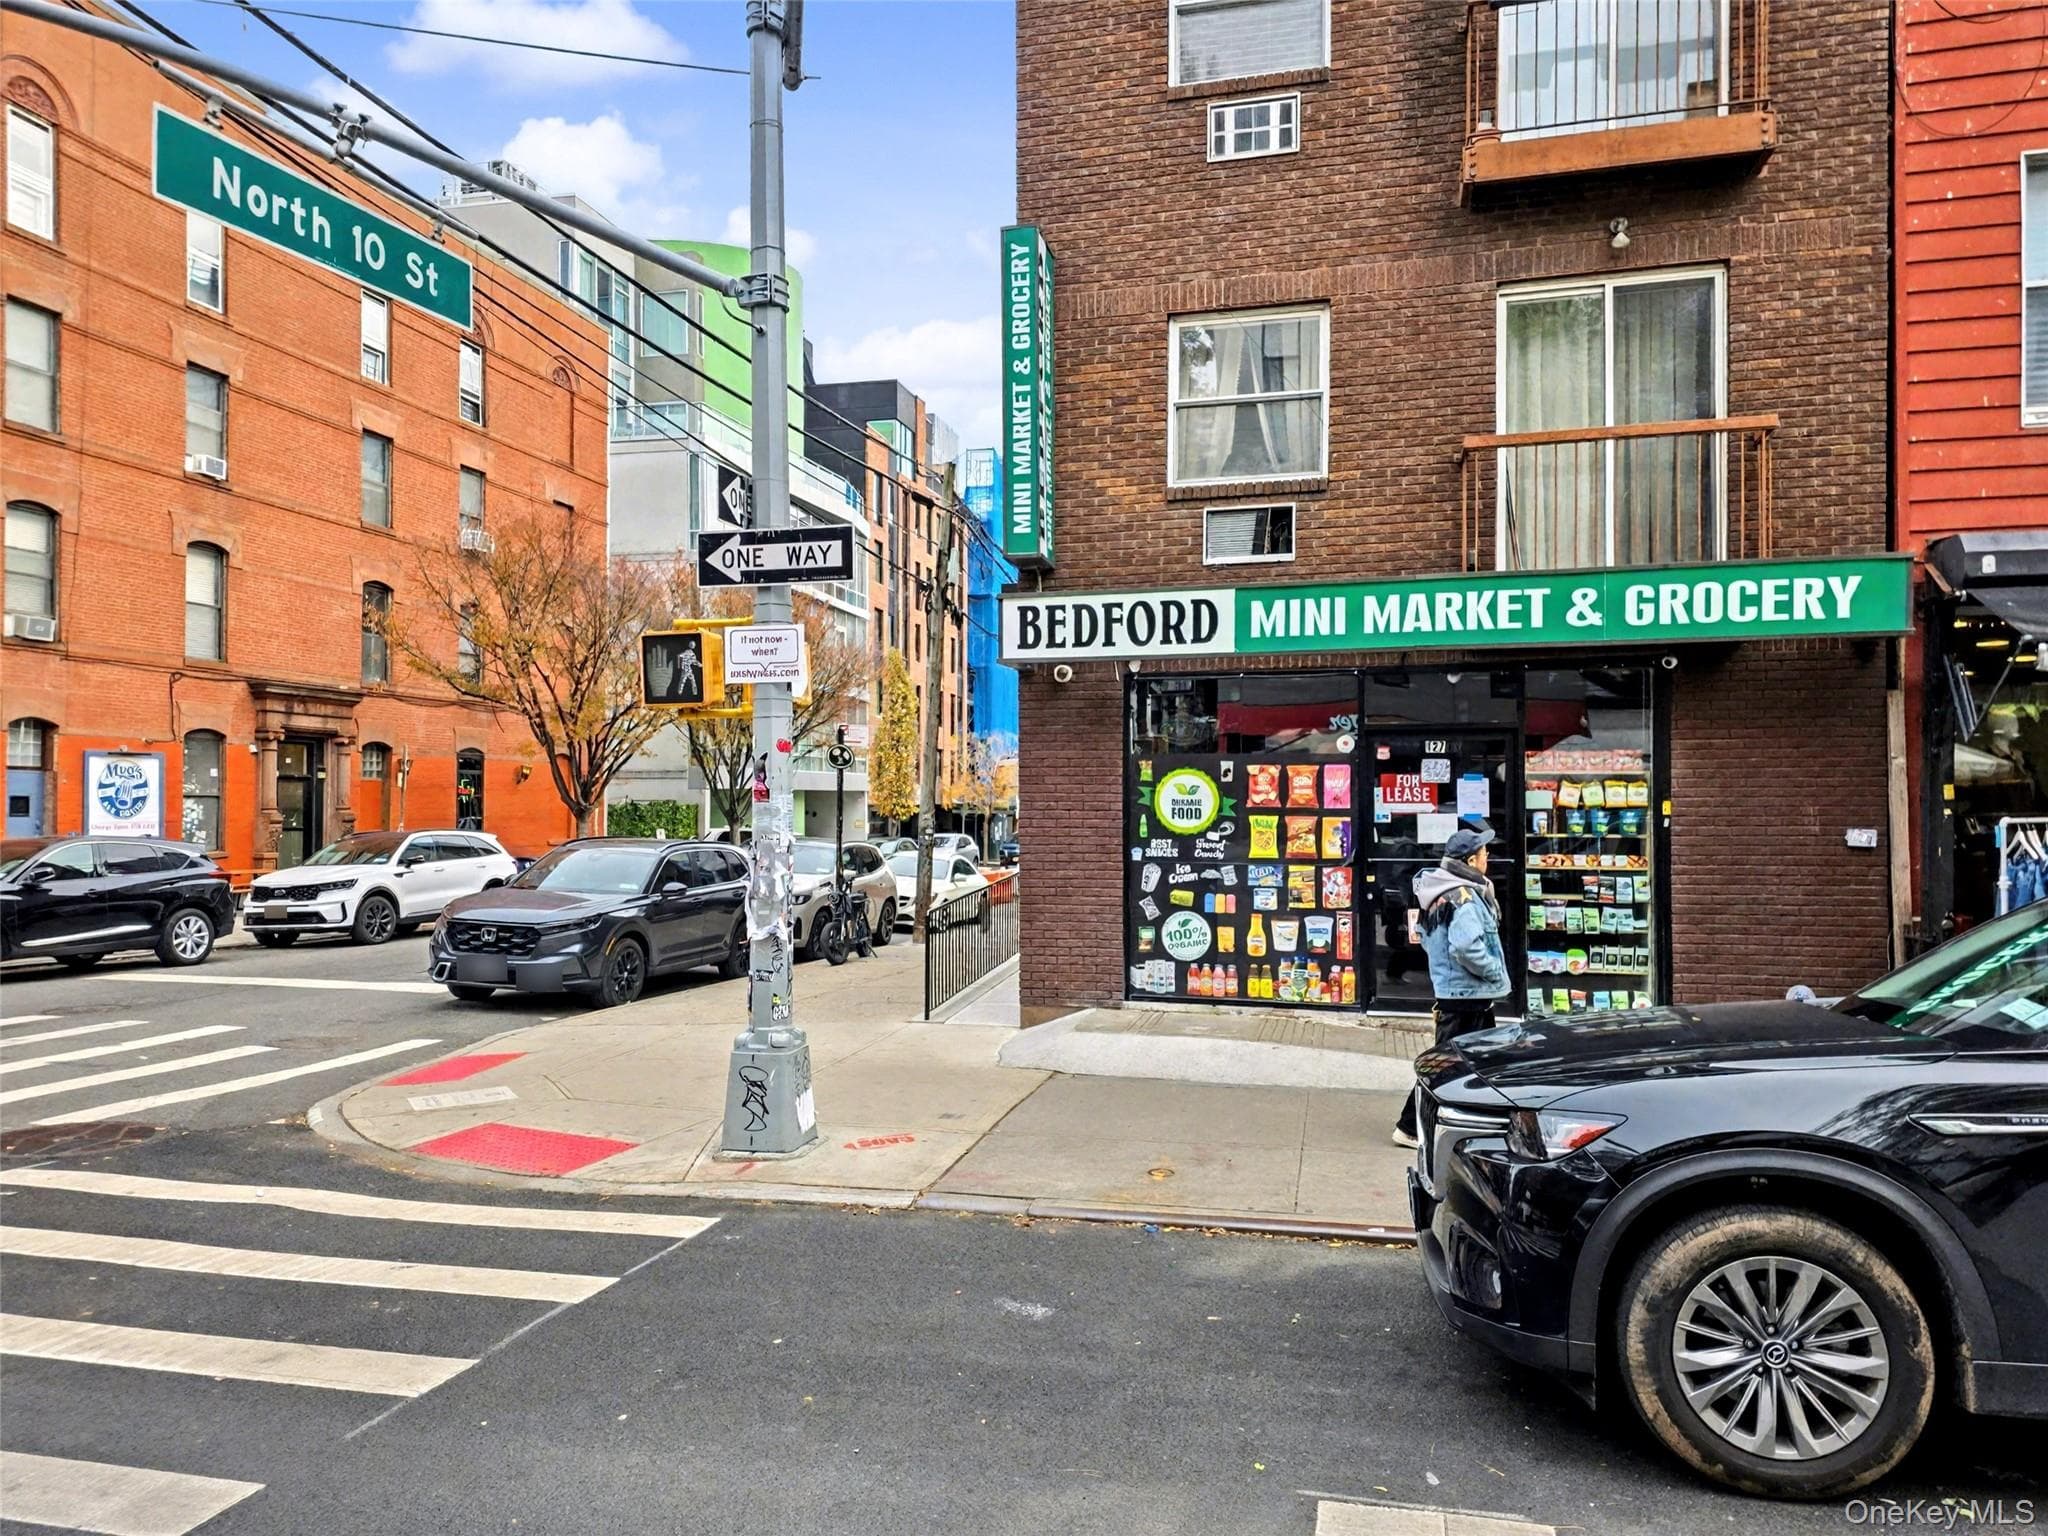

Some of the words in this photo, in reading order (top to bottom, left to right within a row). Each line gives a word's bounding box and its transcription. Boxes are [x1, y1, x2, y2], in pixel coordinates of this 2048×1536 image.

[212, 155, 331, 249] North
[352, 224, 386, 271] 10
[405, 252, 439, 297] St
[1010, 242, 1031, 351] GROCERY
[1012, 356, 1031, 375] &
[1011, 382, 1032, 475] MARKET
[1012, 484, 1032, 534] MINI
[722, 547, 765, 569] ONE
[786, 543, 832, 567] WAY
[1016, 598, 1220, 650] BEDFORD
[1249, 596, 1346, 639] MINI
[1362, 587, 1552, 634] MARKET
[1565, 587, 1603, 627] &
[1623, 575, 1863, 627] GROCERY
[749, 635, 763, 644] not
[764, 636, 783, 644] now
[1396, 774, 1420, 787] FOR
[1386, 787, 1431, 802] LEASE
[1171, 807, 1202, 820] FOOD
[1166, 926, 1208, 942] 100%
